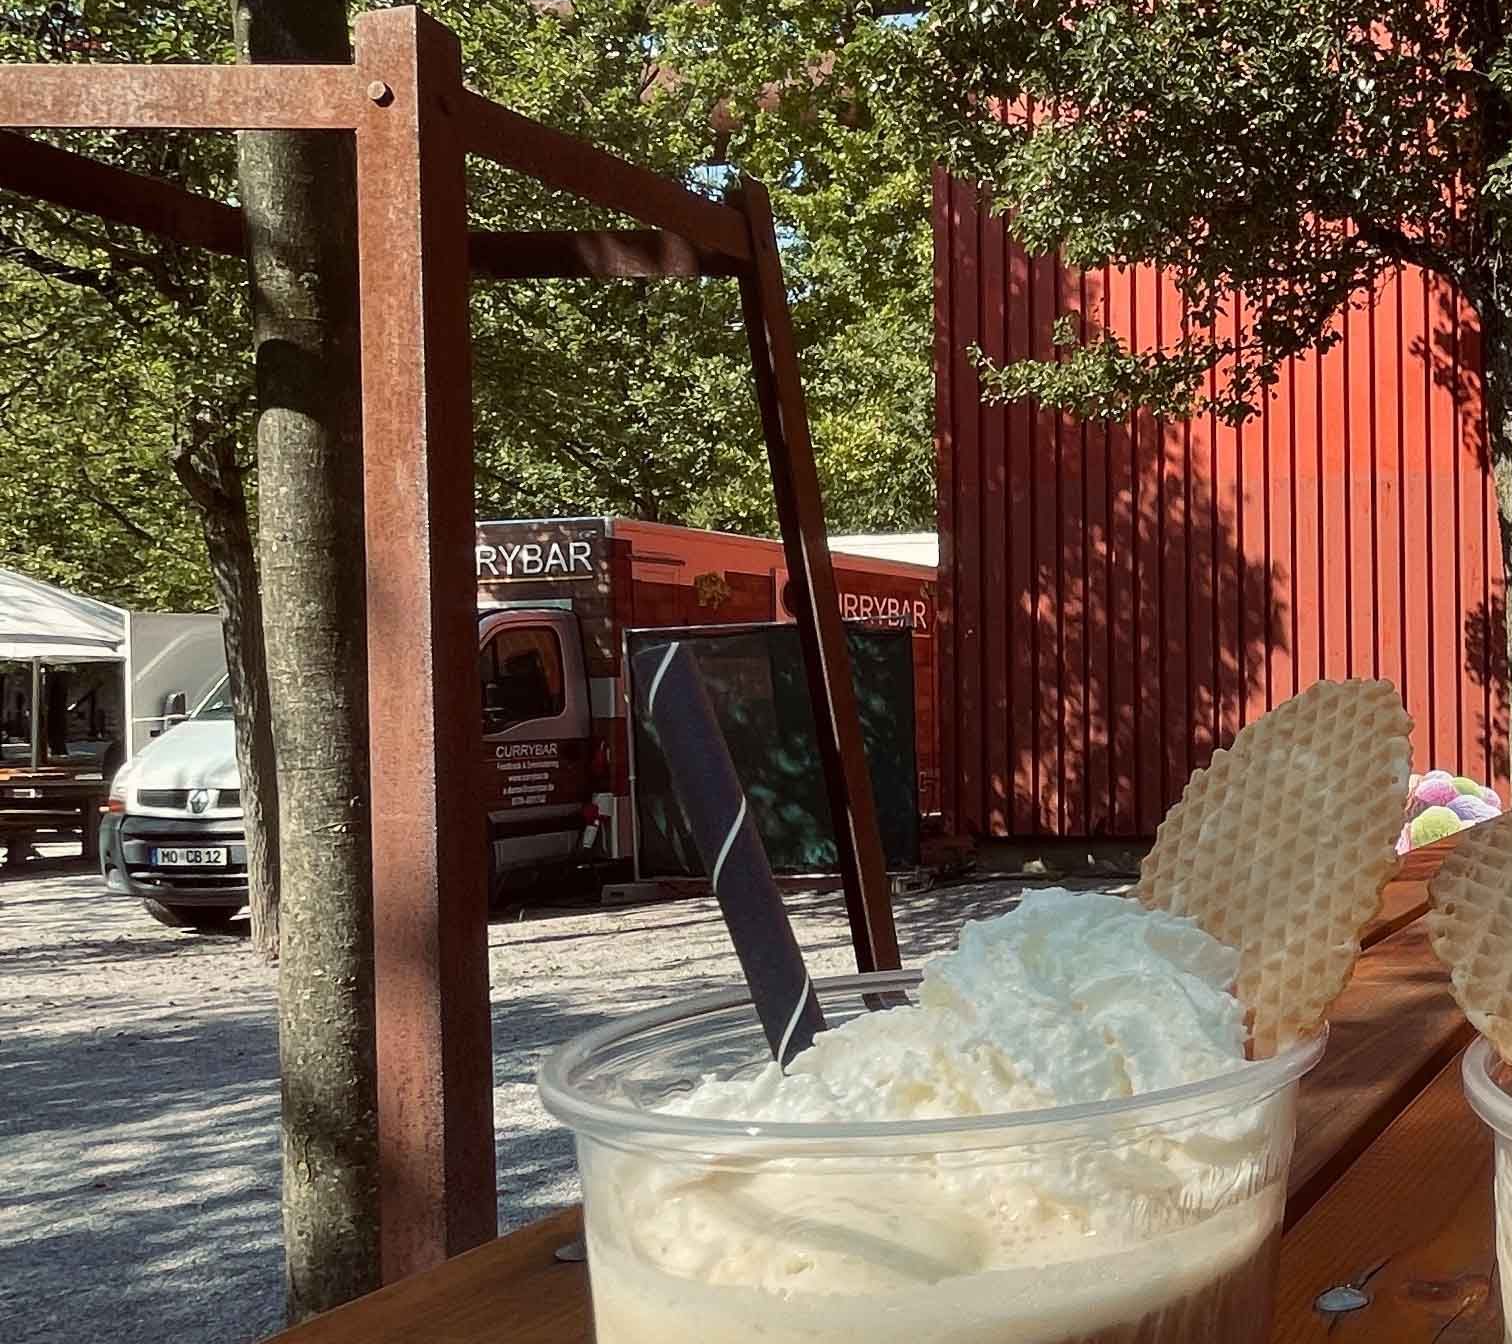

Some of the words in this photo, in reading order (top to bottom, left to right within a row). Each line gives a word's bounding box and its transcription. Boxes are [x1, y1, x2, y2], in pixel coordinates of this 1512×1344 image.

[839, 592, 927, 629] RRYBAR
[496, 743, 558, 758] CURRYBAR
[205, 850, 221, 864] 12
